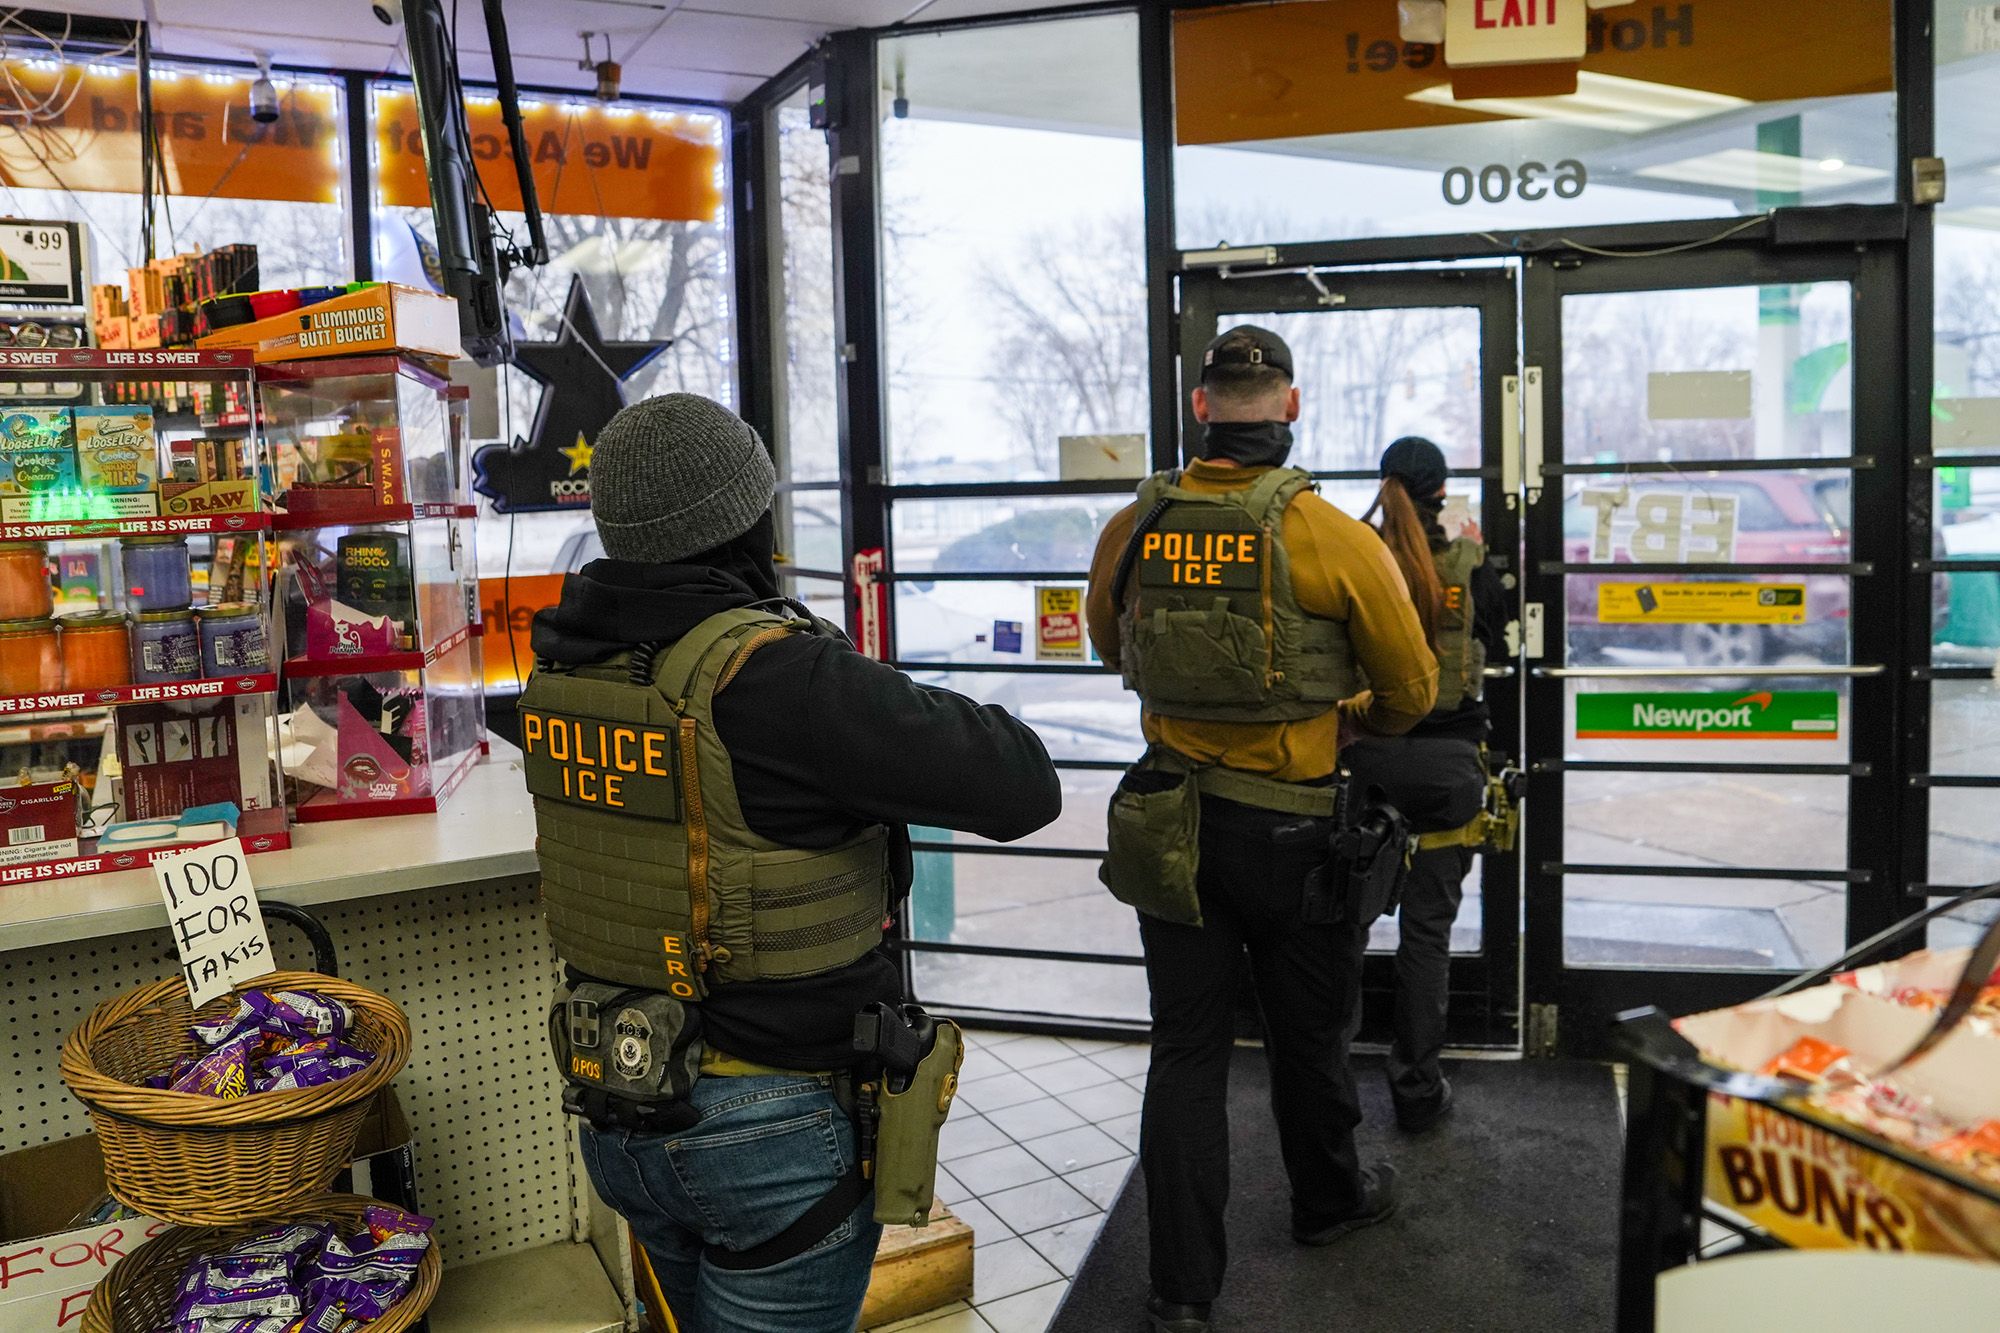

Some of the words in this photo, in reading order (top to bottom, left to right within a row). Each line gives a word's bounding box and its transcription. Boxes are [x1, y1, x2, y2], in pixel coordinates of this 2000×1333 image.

[313, 306, 386, 329] LUMINOUS
[299, 331, 332, 349] BUTT
[336, 323, 387, 343] BUCKET
[10, 352, 59, 364] SWEET
[106, 352, 136, 364] LIFE
[138, 352, 152, 364] IS
[156, 352, 200, 364] SWEET
[15, 454, 56, 467] Cookies
[98, 450, 138, 462] Cookies
[16, 470, 56, 482] Cream
[103, 470, 139, 487] MILK
[189, 490, 245, 513] RAW
[5, 526, 22, 538] IS
[24, 524, 72, 537] SWEET
[119, 521, 148, 533] LIFE
[151, 520, 167, 532] IS
[168, 518, 213, 531] SWEET
[1143, 533, 1257, 563] POLICE
[1173, 562, 1223, 585] ICE
[1046, 615, 1073, 627] We
[1043, 625, 1078, 639] Card
[131, 687, 161, 700] LIFE
[163, 686, 178, 697] IS
[181, 682, 224, 696] SWEET
[18, 697, 36, 710] IS
[38, 693, 85, 708] SWEET
[1633, 703, 1752, 732] Newport
[524, 713, 668, 777] POLICE
[370, 783, 398, 791] LOVE
[562, 767, 625, 807] ICE
[20, 795, 64, 805] CIGARILLOS
[22, 851, 59, 860] alternative
[24, 845, 47, 854] Cigars
[2, 867, 33, 882] LIFE
[36, 865, 53, 878] IS
[55, 859, 102, 875] SWEET
[175, 895, 252, 952] FOR
[663, 936, 694, 997] ERO
[580, 1058, 601, 1080] POS
[1719, 1145, 1906, 1250] BUNS
[0, 1228, 128, 1289] FOR
